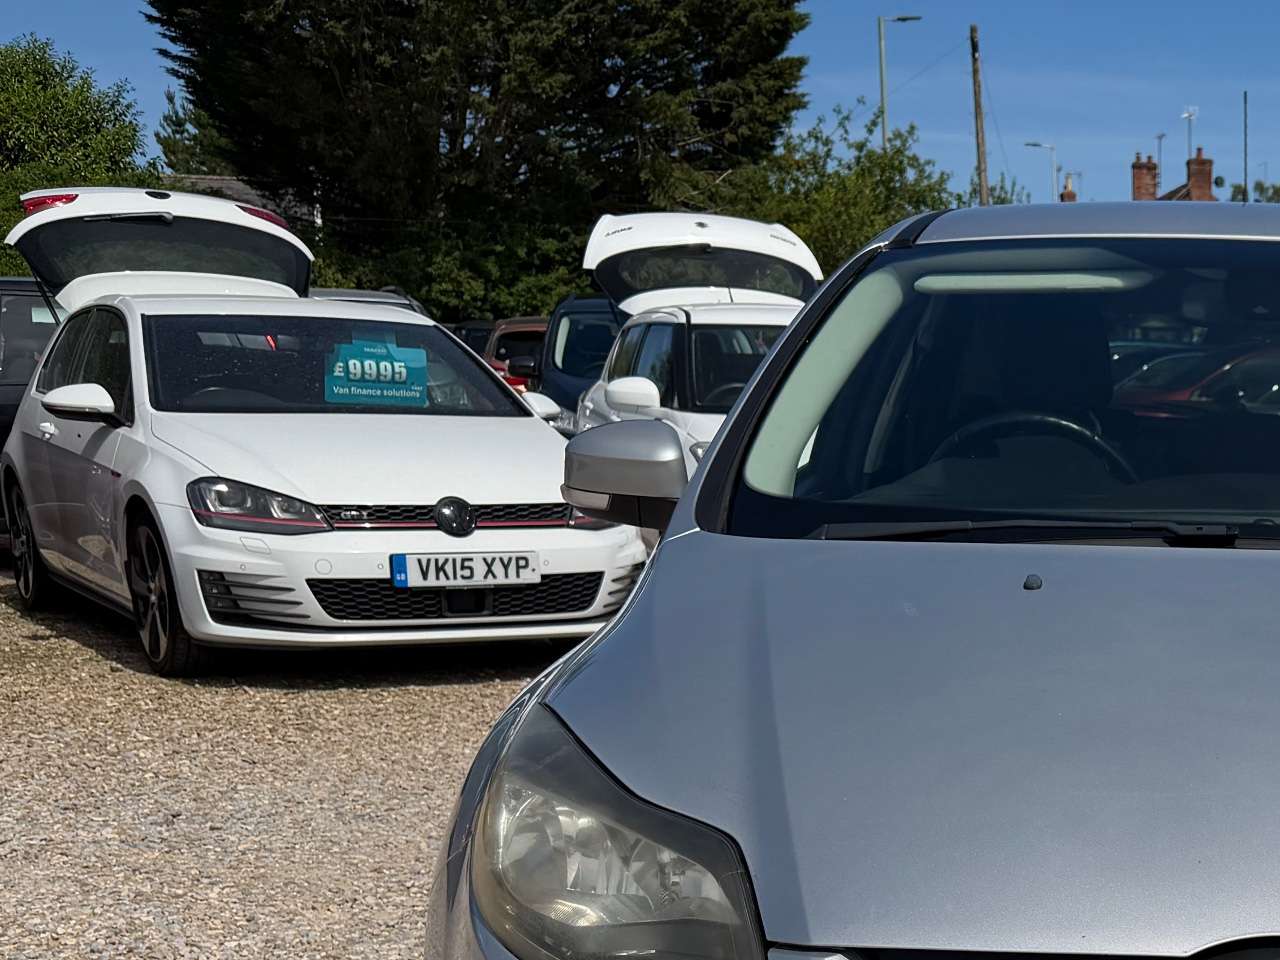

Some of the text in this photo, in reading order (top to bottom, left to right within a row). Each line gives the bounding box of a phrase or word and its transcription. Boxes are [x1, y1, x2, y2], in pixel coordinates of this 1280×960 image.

[333, 386, 349, 394] Van
[351, 386, 381, 396] finance
[383, 388, 420, 398] solutions
[416, 556, 530, 581] VK15 XYP
